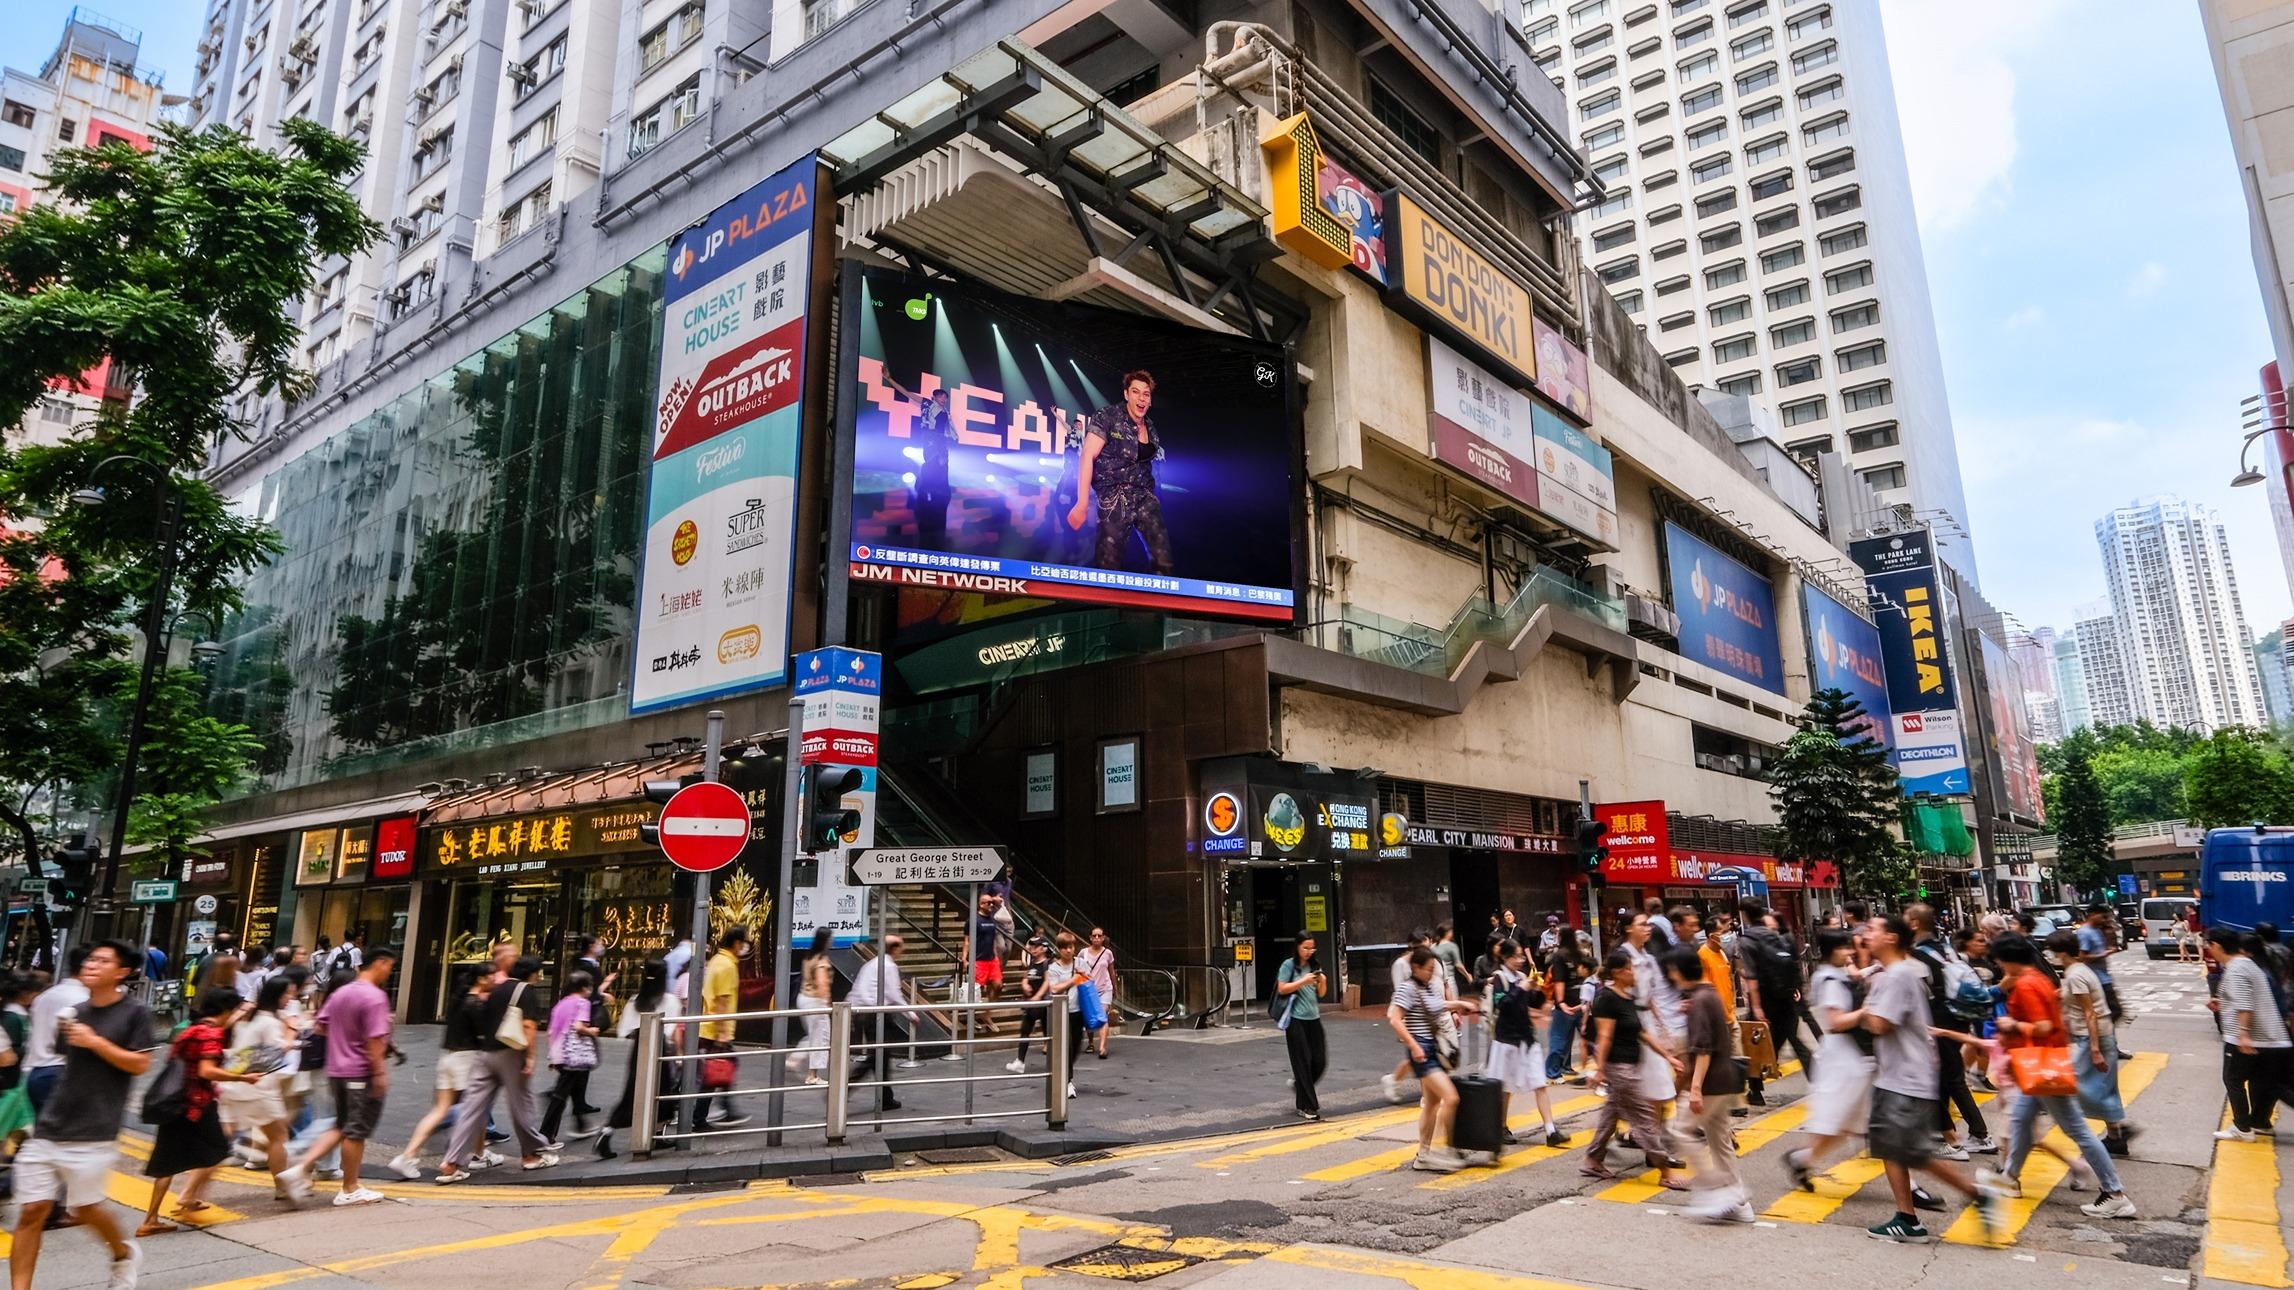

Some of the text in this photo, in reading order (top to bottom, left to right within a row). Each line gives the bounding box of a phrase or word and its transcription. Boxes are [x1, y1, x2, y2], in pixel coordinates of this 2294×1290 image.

[699, 182, 808, 263] JP PLAZA
[1420, 217, 1463, 279] DON
[755, 260, 786, 293] 影藝
[683, 281, 748, 330] CINEART
[753, 287, 785, 321] 戲院
[1424, 253, 1519, 360] DONKI
[684, 310, 741, 355] HOUSE
[658, 377, 682, 418] NOW
[697, 357, 793, 417] OUTBACK
[659, 379, 694, 434] OPEN!
[714, 394, 768, 427] STEAKHOUSE
[695, 435, 746, 484] Festiva
[1468, 448, 1512, 483] OUTBACK
[727, 508, 765, 538] SUPER
[1874, 547, 1922, 561] THE PARK LANE
[720, 567, 765, 599] 米線陣
[852, 563, 1028, 594] JM NETWORK
[658, 589, 703, 617] 上海姥姥
[1713, 583, 1762, 629] JP PLAZA
[977, 636, 1042, 666] CINEART
[1904, 586, 1943, 695] IKEA
[1838, 641, 1882, 688] JP PLAZA
[799, 679, 807, 688] JP
[836, 675, 877, 688] JP PLAZA
[832, 742, 874, 754] OUTBACK
[1900, 747, 1955, 759] DECATHLON
[1029, 775, 1053, 785] CINEART
[1106, 764, 1133, 775] CINEART
[1108, 774, 1132, 784] HOUSE
[1030, 784, 1052, 793] HOUSE
[1317, 811, 1368, 829] EXCHANGE
[1329, 803, 1367, 815] HONG KONG
[1610, 813, 1647, 833] 惠康
[468, 816, 571, 860] 老鳳祥銀樓
[1204, 838, 1244, 851] CHANGE
[1406, 827, 1515, 849] PEARL CITY MANSION
[1606, 835, 1655, 845] wellcome
[380, 850, 406, 864] TUDOR
[876, 852, 983, 864] Great George Street
[1379, 847, 1407, 858] CHANGE
[1608, 857, 1626, 870] 24
[895, 865, 964, 880] 記利佐治街
[2232, 871, 2287, 882] BRINKS
[200, 901, 214, 909] 25
